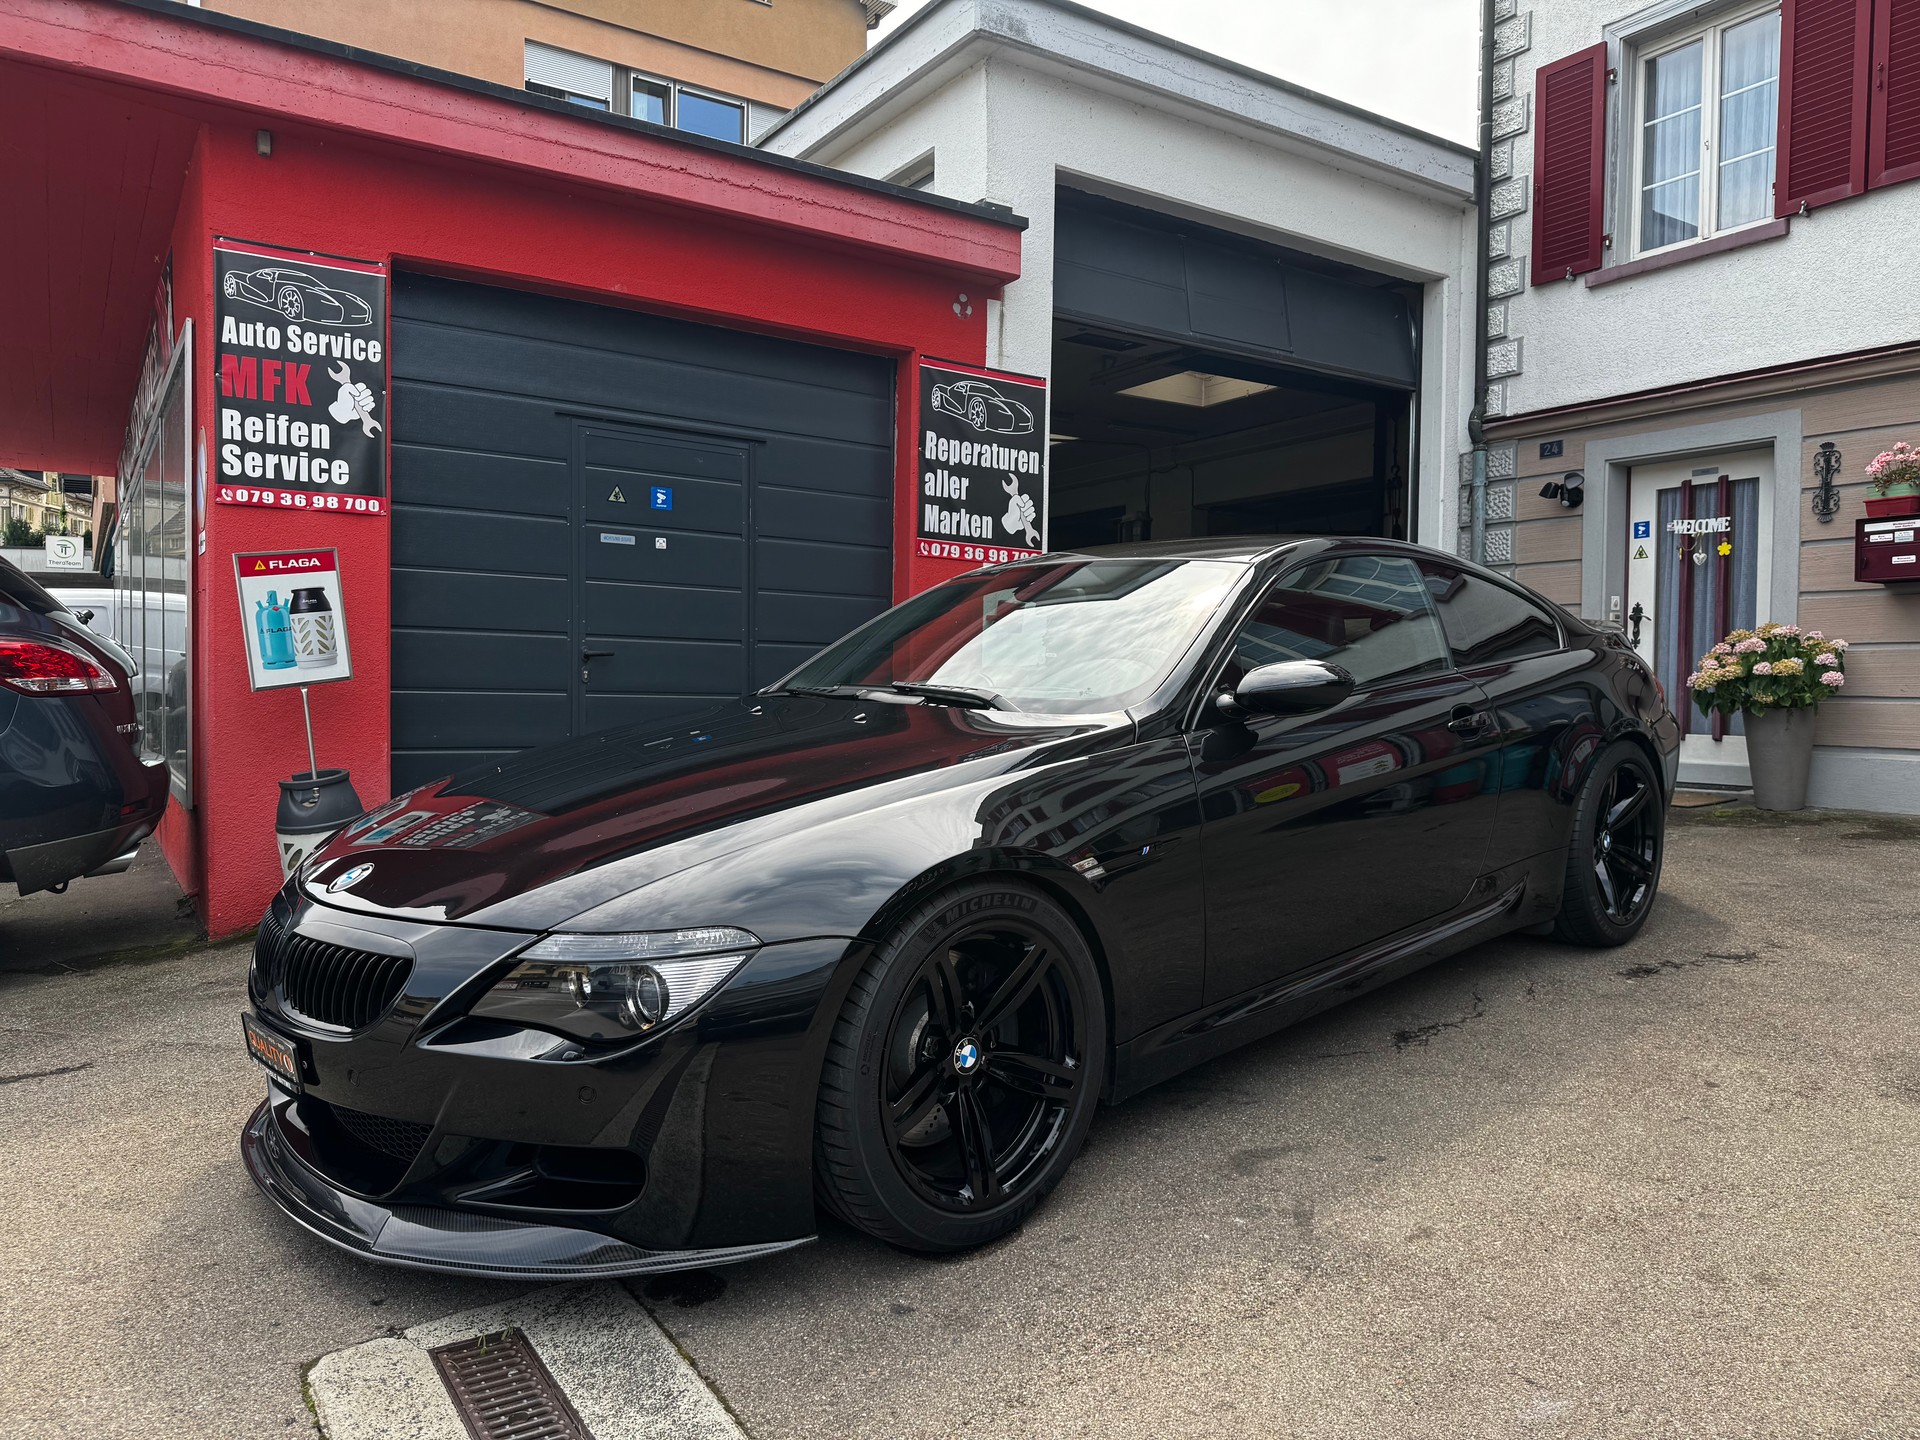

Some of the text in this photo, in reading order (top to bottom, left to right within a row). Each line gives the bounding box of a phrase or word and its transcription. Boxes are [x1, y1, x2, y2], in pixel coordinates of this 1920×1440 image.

[222, 316, 382, 362] Auto Service
[222, 354, 312, 406] MFK
[222, 408, 330, 450] Reifen
[222, 444, 350, 485] Service
[925, 430, 1040, 474] Reperaturen
[1544, 443, 1559, 455] 24
[924, 469, 969, 500] aller
[236, 489, 380, 512] 079 36 98 700
[924, 504, 992, 539] Marken
[1673, 516, 1731, 534] WELCOME
[269, 557, 321, 569] FLAGA
[931, 543, 960, 558] 079
[964, 546, 984, 560] 36
[988, 549, 1008, 562] 98
[945, 894, 1032, 924] MICHELIN
